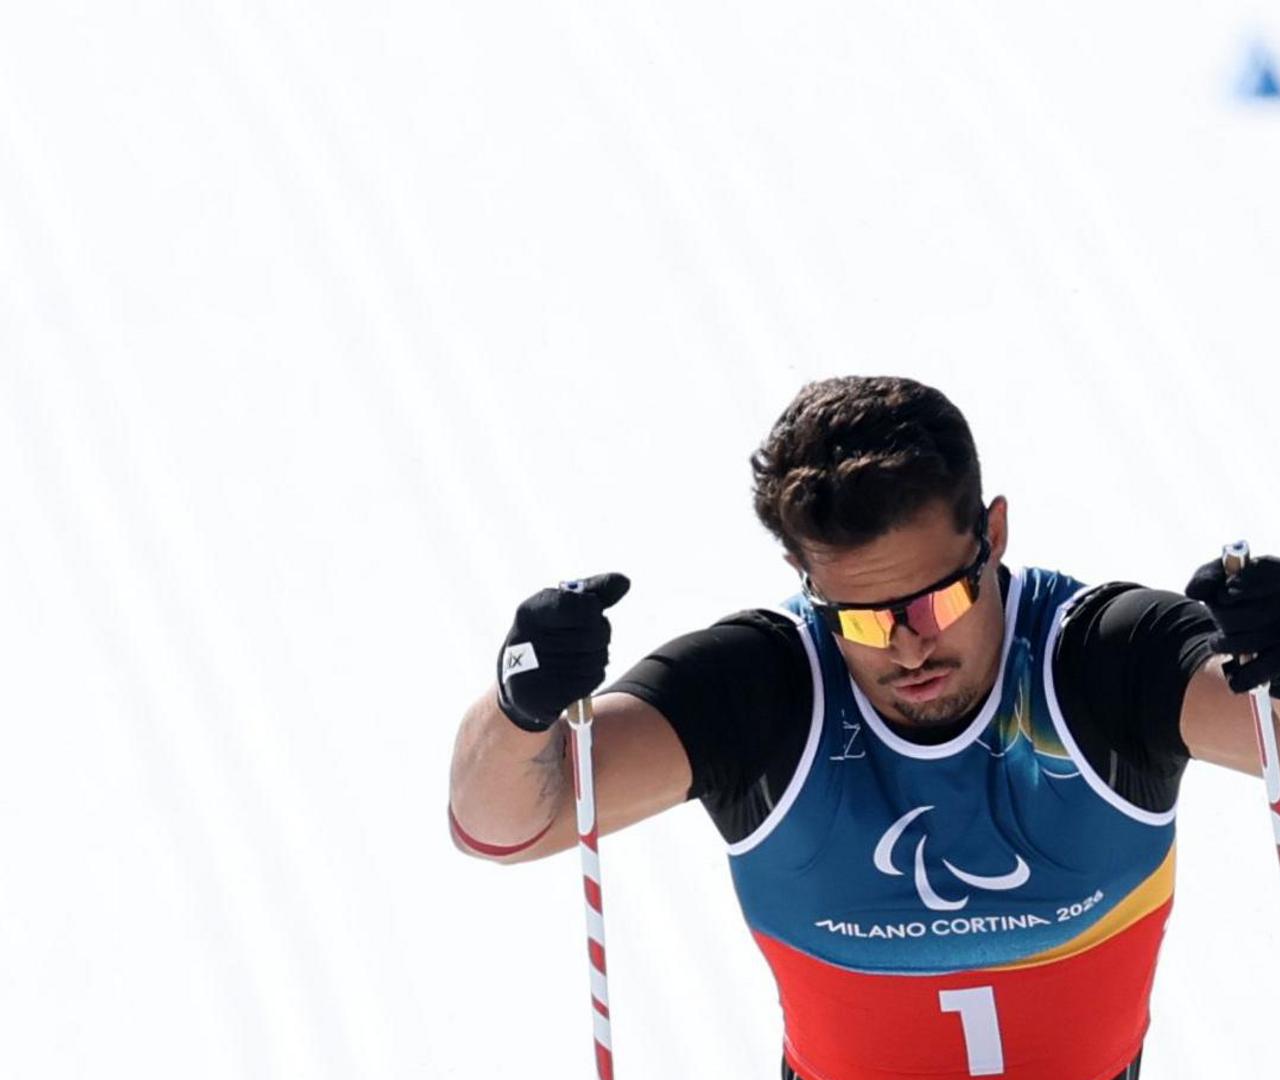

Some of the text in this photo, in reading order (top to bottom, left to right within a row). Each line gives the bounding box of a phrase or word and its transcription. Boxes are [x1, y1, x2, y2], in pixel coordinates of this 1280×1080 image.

[815, 889, 1104, 940] MILANO CORTINA 2026
[938, 985, 1005, 1077] 1
